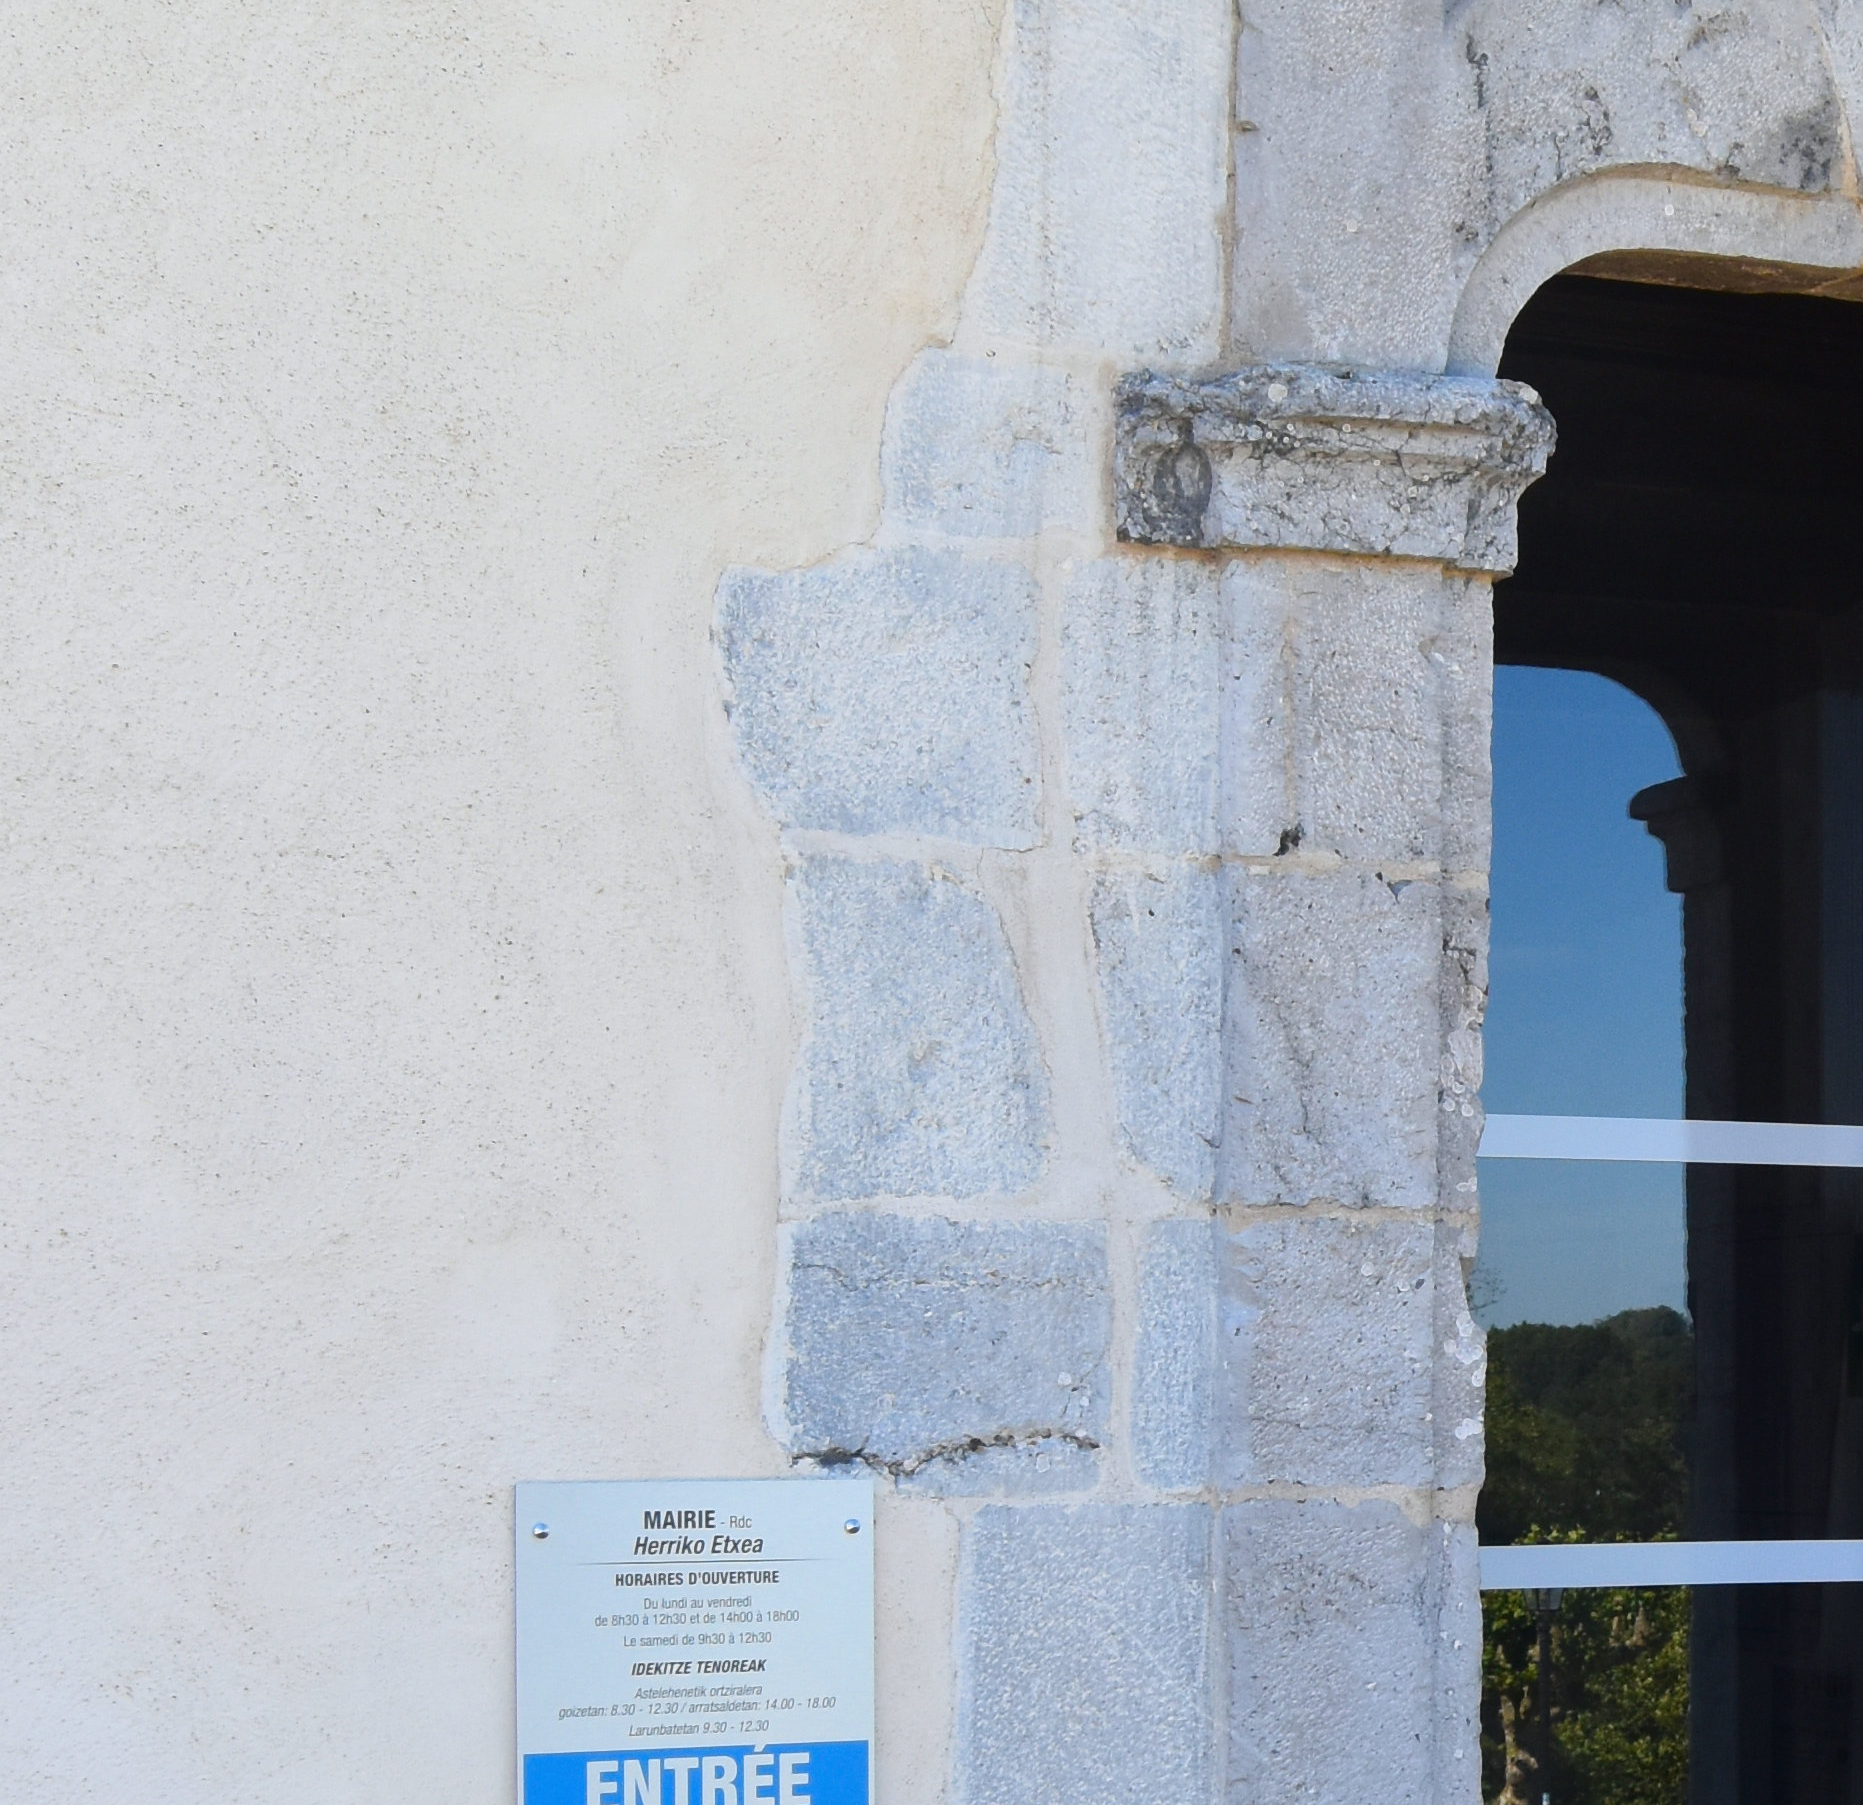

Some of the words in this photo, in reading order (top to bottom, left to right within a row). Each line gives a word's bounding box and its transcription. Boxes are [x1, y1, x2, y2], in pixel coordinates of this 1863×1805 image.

[644, 1509, 716, 1530] MAIRIE
[730, 1515, 753, 1528] Rdc
[633, 1535, 705, 1556] Herriko
[710, 1535, 764, 1554] Etxea
[615, 1572, 684, 1587] HORAIRES
[688, 1570, 780, 1585] D'OUVERTURE
[643, 1597, 658, 1610] Du
[661, 1597, 688, 1610] lundi
[690, 1599, 704, 1609] au
[707, 1595, 752, 1608] vendredi
[594, 1614, 608, 1627] de
[611, 1614, 639, 1627] 8h30
[642, 1613, 649, 1626] à
[653, 1612, 687, 1625] 12h30
[689, 1612, 700, 1625] et
[703, 1612, 716, 1624] de
[720, 1610, 753, 1623] 14h00
[756, 1610, 763, 1623] à
[767, 1610, 800, 1622] 18h00
[623, 1635, 637, 1647] Le
[639, 1633, 679, 1647] samedi
[681, 1633, 695, 1646] de
[697, 1632, 726, 1645] 9h30
[728, 1632, 735, 1644] à
[739, 1631, 772, 1644] 12h30
[631, 1661, 692, 1676] IDEKITZE
[697, 1659, 767, 1674] TENOREAK
[634, 1685, 707, 1700] Astelehenetik
[610, 1703, 637, 1717] 8.30
[648, 1702, 680, 1716] 12.30
[765, 1697, 796, 1711] 14.00
[807, 1696, 837, 1709] 18.00
[628, 1722, 700, 1737] Larunbatetan
[702, 1721, 728, 1734] 9.30
[740, 1719, 770, 1733] 12.30
